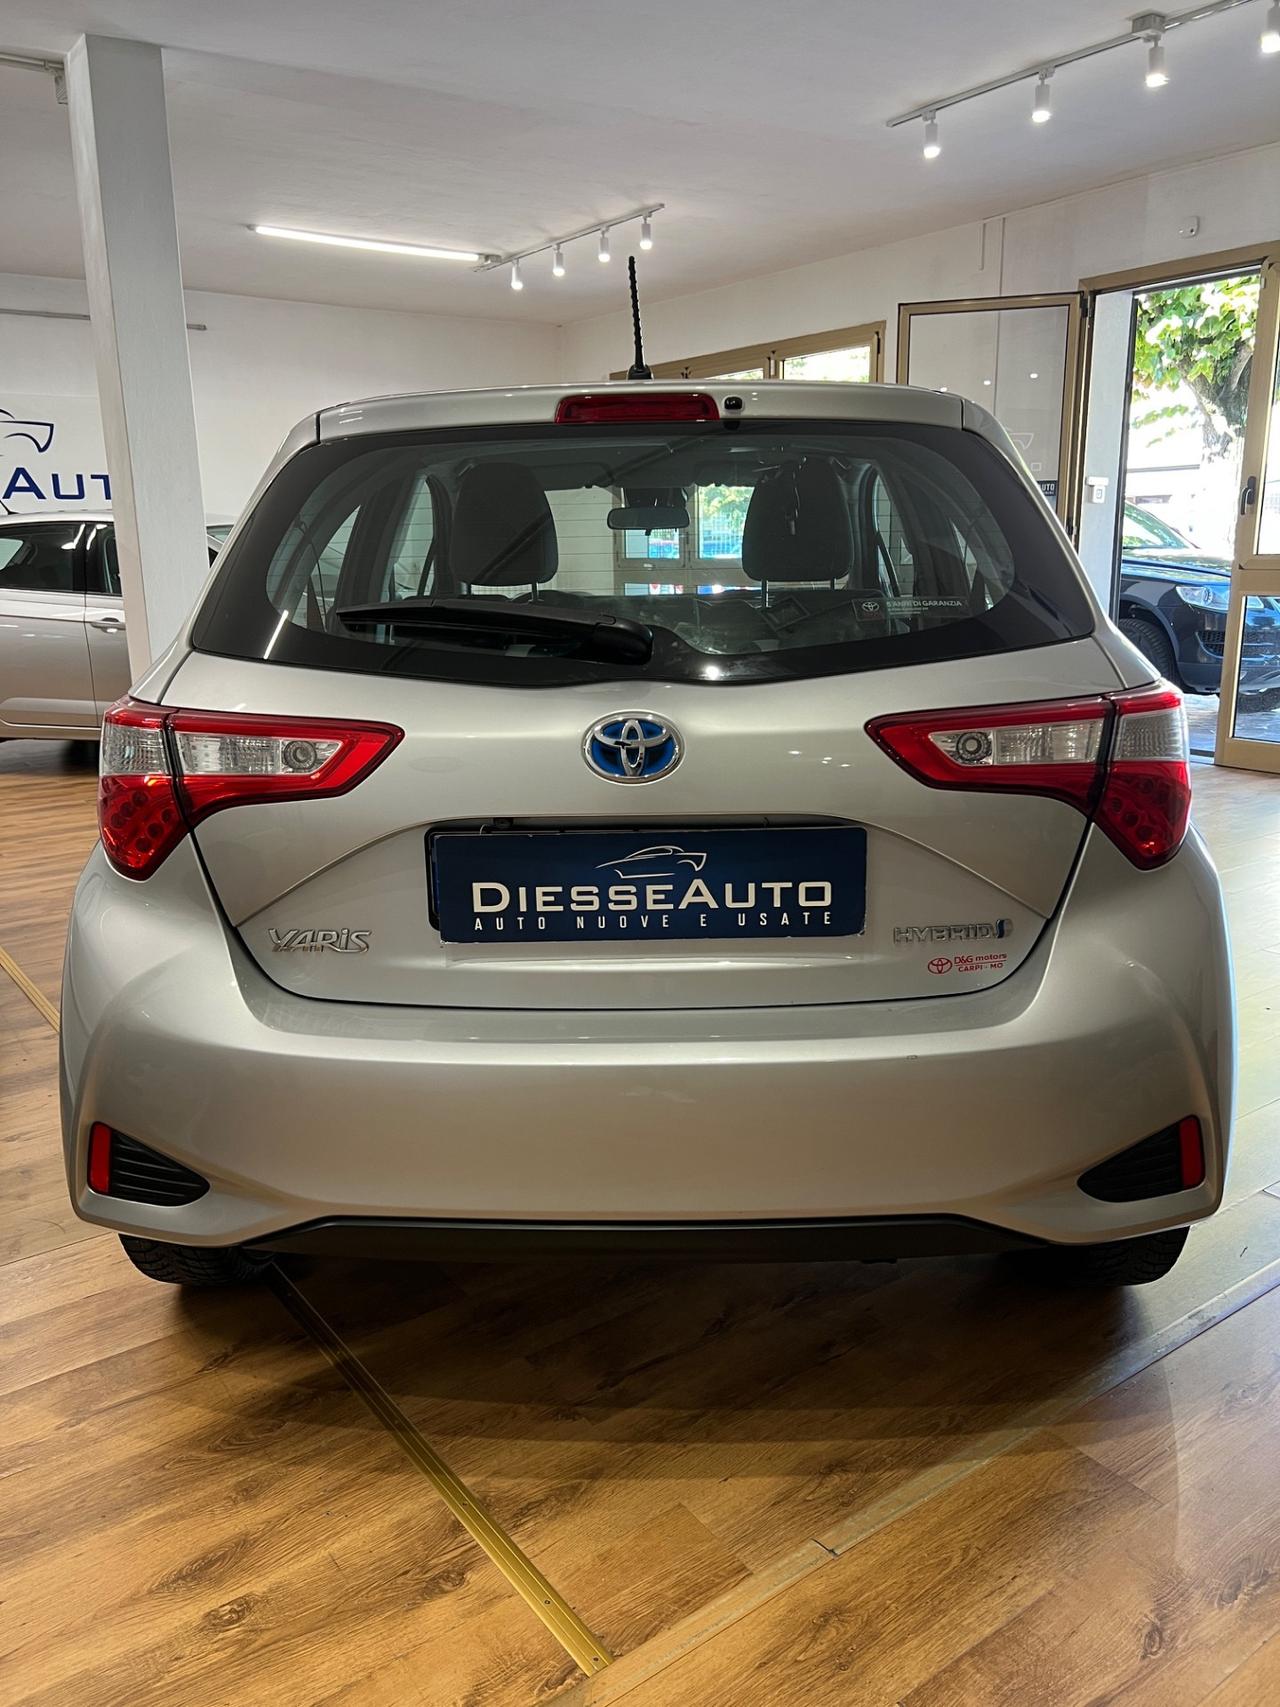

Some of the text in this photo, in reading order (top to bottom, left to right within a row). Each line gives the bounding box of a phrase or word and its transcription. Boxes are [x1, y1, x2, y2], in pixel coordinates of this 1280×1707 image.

[2, 467, 112, 500] AUT
[1041, 483, 1055, 491] UTO
[473, 879, 831, 913] DIESSEAUTO
[475, 912, 831, 931] AUTO NUOVE E USATE
[894, 924, 994, 942] HYBRID
[954, 953, 1007, 964] D&G motors
[958, 965, 983, 973] CARPI
